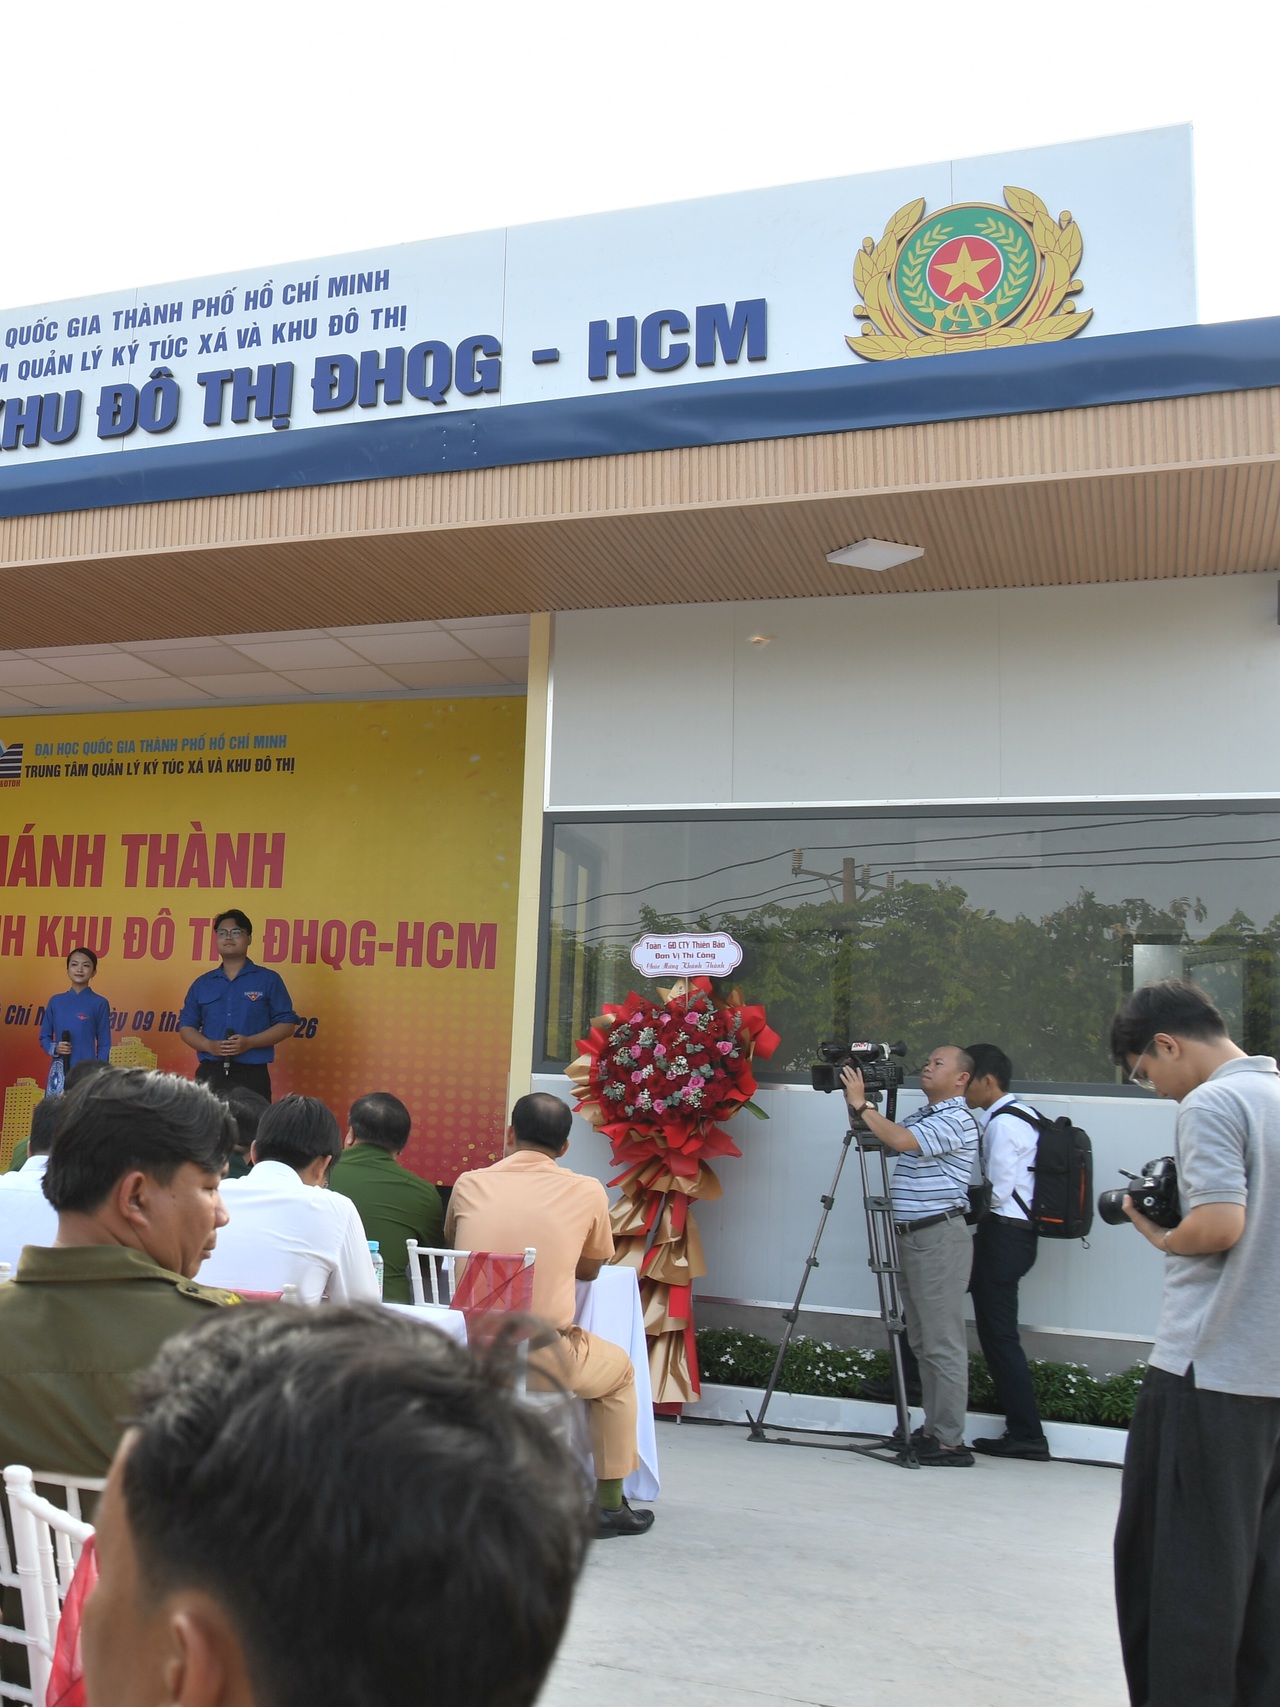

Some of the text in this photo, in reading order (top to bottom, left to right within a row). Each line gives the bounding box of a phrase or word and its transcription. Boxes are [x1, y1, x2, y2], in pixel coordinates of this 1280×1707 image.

[5, 316, 59, 348] QUỐC
[66, 314, 101, 339] GIA
[113, 302, 183, 333] THÀNH
[192, 286, 237, 322] PHỐ
[244, 278, 273, 312] HỒ
[282, 274, 320, 306] CHÍ
[328, 269, 390, 299] MINH
[18, 349, 73, 383] QUẢN
[80, 345, 104, 372] LÝ
[111, 338, 138, 367] KÝ
[149, 330, 188, 362] TÚC
[198, 326, 229, 354] XÁ
[236, 320, 261, 349] VÀ
[272, 317, 318, 343] KHU
[328, 307, 359, 336] ĐÔ
[370, 304, 407, 332] THỊ
[96, 366, 181, 441] ĐÔ
[197, 360, 296, 431] THỊ
[311, 334, 502, 414] ĐHQG
[531, 347, 560, 365] -
[587, 297, 769, 382] HCM
[25, 755, 296, 779] TRUNG TÂM QUẢN LÝ KÝ TÚC XÁ VÀ KHU ĐÔ THỊ
[34, 742, 54, 759] ĐẠI
[57, 741, 79, 759] HỌC
[83, 736, 113, 755] QUỐC
[116, 740, 136, 754] GIA
[140, 736, 179, 753] THÀNH
[181, 733, 207, 752] PHỐ
[229, 732, 250, 750] CHÍ
[253, 734, 288, 749] MINH
[121, 821, 286, 889] THÀNH
[36, 915, 113, 960] KHU
[122, 907, 176, 961] ĐÔ
[262, 918, 499, 972] ĐHQG-HCM
[4, 1003, 34, 1026] Chí
[131, 1010, 155, 1031] 09
